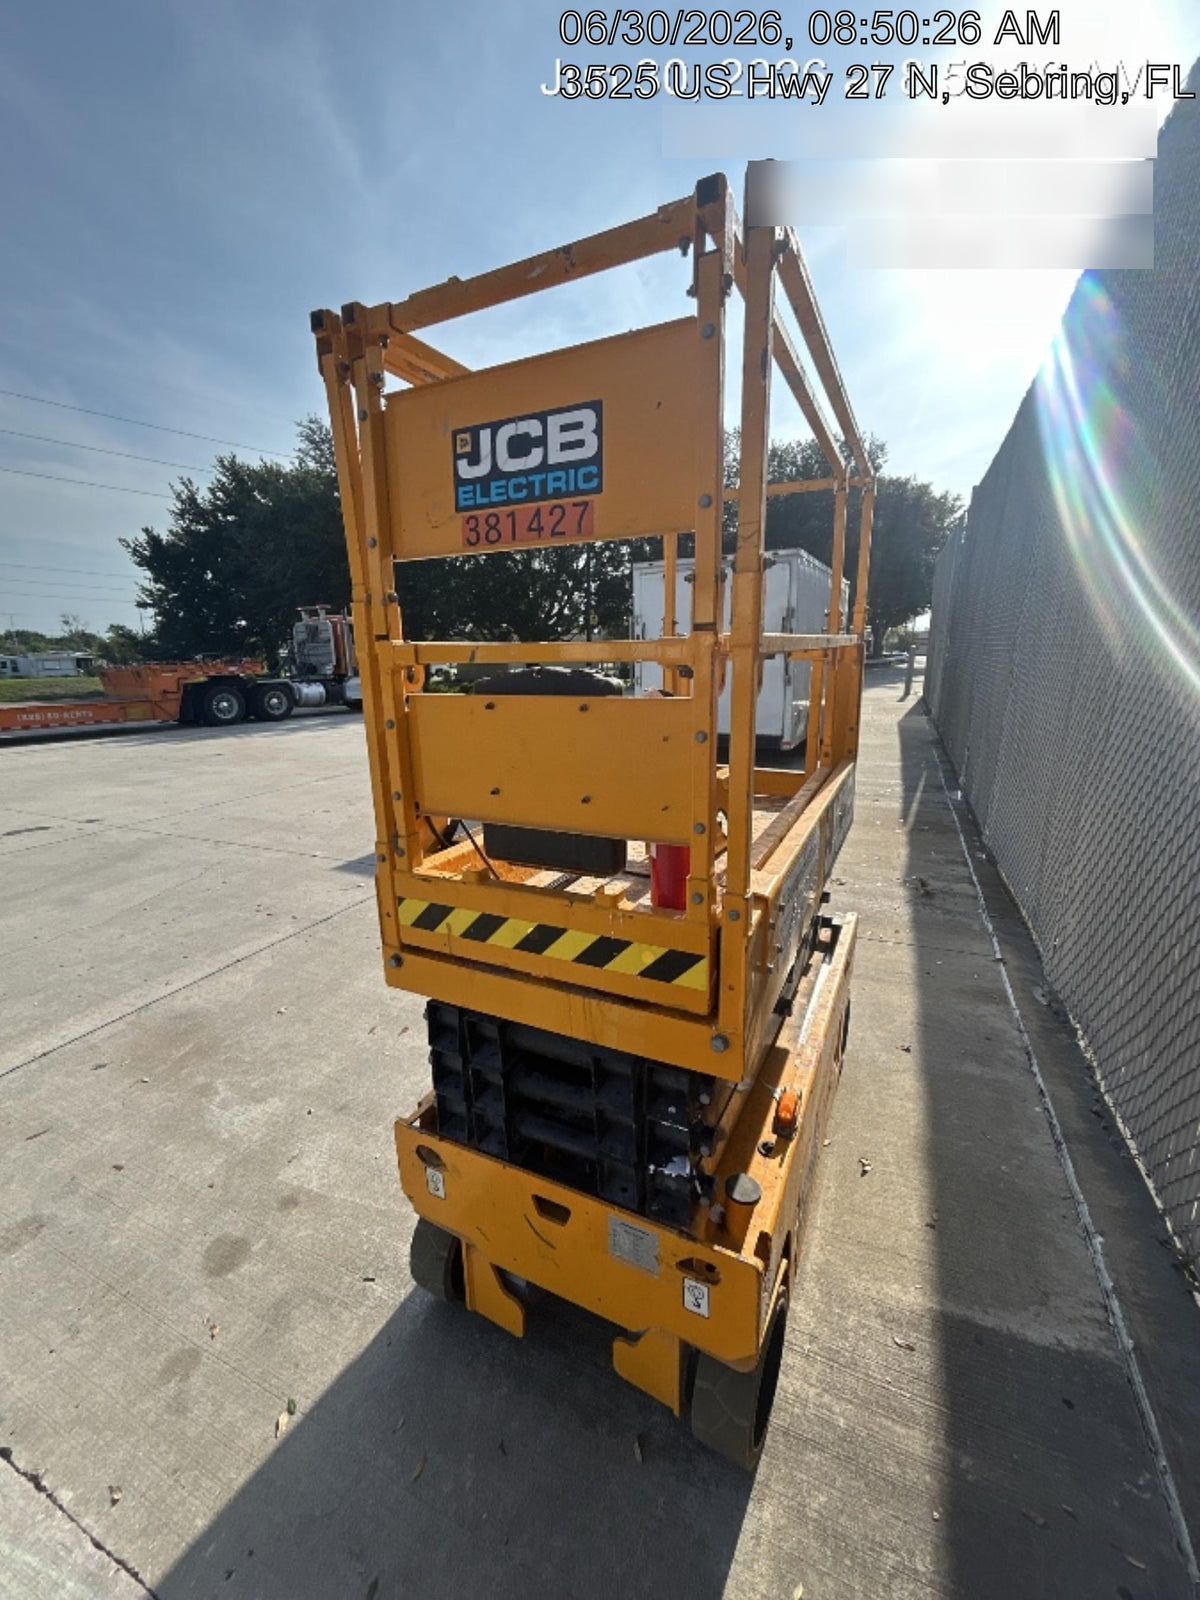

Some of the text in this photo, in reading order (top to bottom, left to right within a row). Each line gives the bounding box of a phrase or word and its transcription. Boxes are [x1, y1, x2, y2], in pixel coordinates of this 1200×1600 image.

[456, 408, 599, 480] JCB
[458, 465, 599, 507] ELECTRIC
[465, 501, 589, 547] 381427
